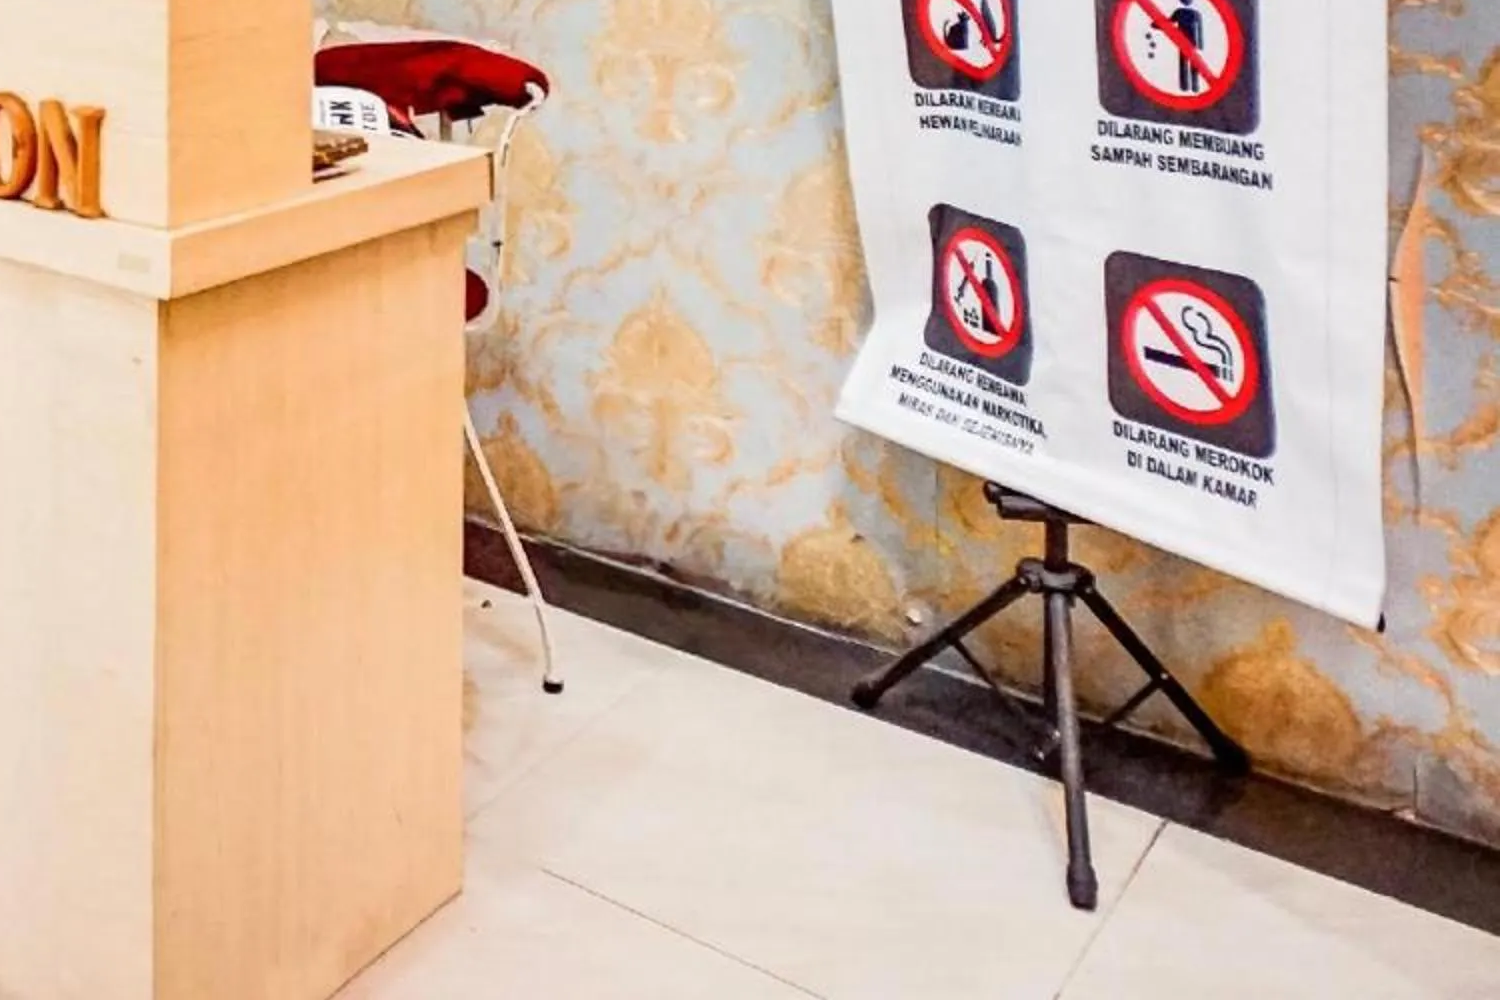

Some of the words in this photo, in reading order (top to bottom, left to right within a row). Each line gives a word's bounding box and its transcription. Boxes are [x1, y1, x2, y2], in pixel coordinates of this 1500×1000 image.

[1097, 119, 1174, 145] DILARANG
[1179, 130, 1265, 161] MEMBUANG
[1090, 144, 1152, 169] SAMPAH
[1157, 155, 1273, 191] SEMBARANGAN
[889, 363, 980, 410] MENGGUNAKAN
[919, 351, 975, 385] DILARANG
[1113, 420, 1191, 457] DILARANG
[1195, 443, 1274, 486] MEROKOK
[1127, 450, 1142, 469] DI
[1145, 456, 1199, 487] DALAM
[1202, 475, 1257, 509] KAMAR
